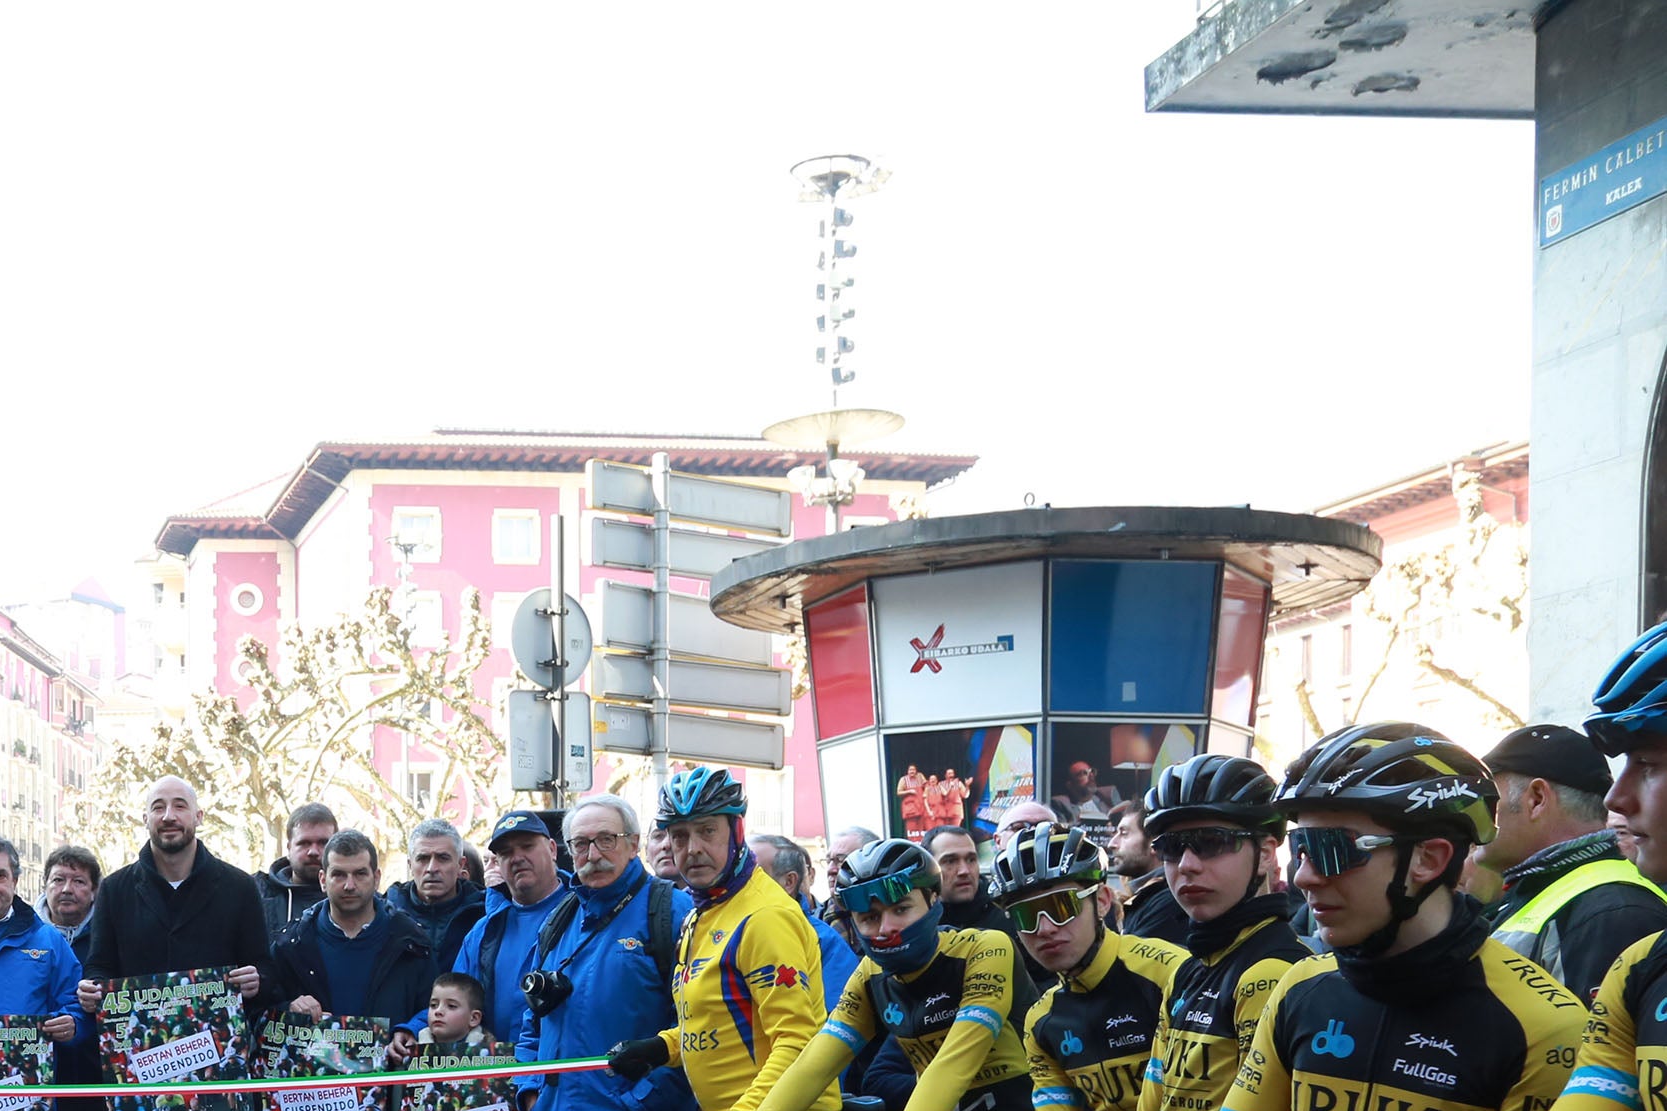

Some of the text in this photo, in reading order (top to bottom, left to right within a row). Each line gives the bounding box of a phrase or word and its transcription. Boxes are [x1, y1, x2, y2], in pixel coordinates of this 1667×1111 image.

[1605, 177, 1643, 206] KALEA
[923, 643, 1005, 659] EIBARKO UDALA
[1404, 779, 1479, 813] Spiuk
[1129, 943, 1179, 966] IRUKI
[1501, 958, 1579, 1009] IRUKI
[102, 980, 225, 1015] 45 UDABERRI
[115, 1023, 127, 1039] 5
[263, 1021, 374, 1044] 45 UDABERRI
[1108, 1032, 1147, 1049] FullGas
[136, 1036, 212, 1069] BERTAN BEHERA
[1405, 1032, 1458, 1057] Spiuk
[141, 1049, 215, 1082] SUSPENDIDO
[268, 1052, 278, 1067] 5
[1392, 1057, 1458, 1086] FullGas
[283, 1086, 353, 1104] BERTAN BEHERA
[414, 1088, 423, 1104] 5
